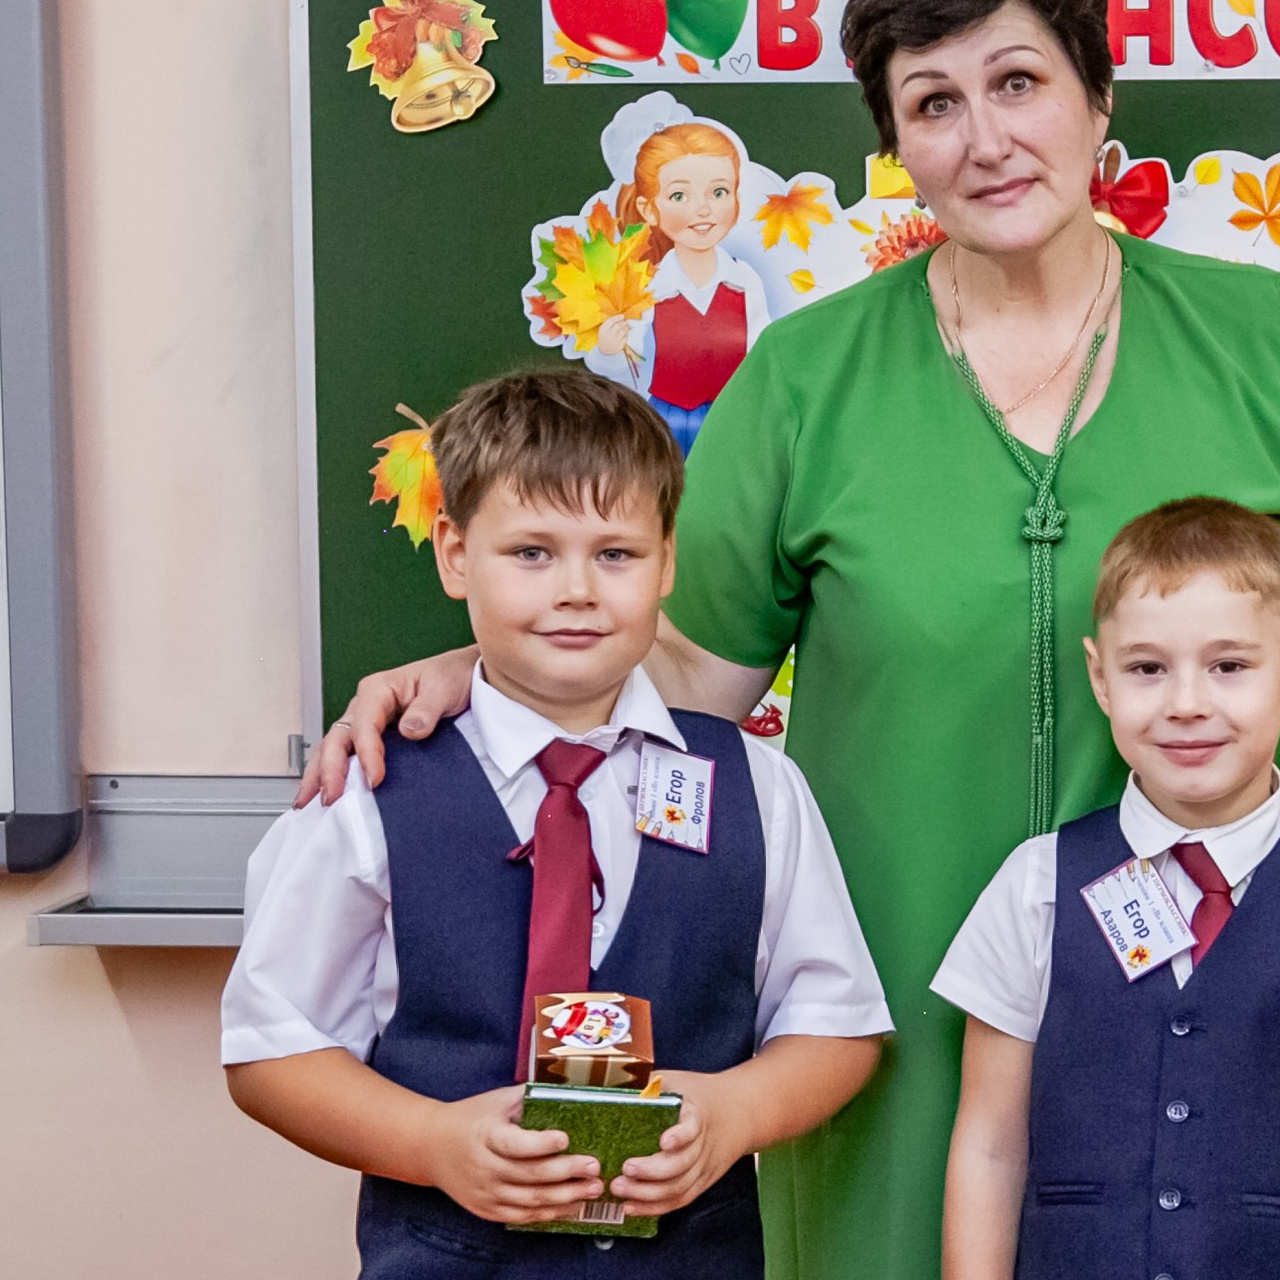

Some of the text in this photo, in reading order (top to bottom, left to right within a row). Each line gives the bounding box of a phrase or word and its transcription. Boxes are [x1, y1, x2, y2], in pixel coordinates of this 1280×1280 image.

[666, 769, 688, 804] Егор
[691, 781, 706, 825] Фролов
[1100, 909, 1129, 952] Азаров
[1123, 898, 1150, 939] Егор
